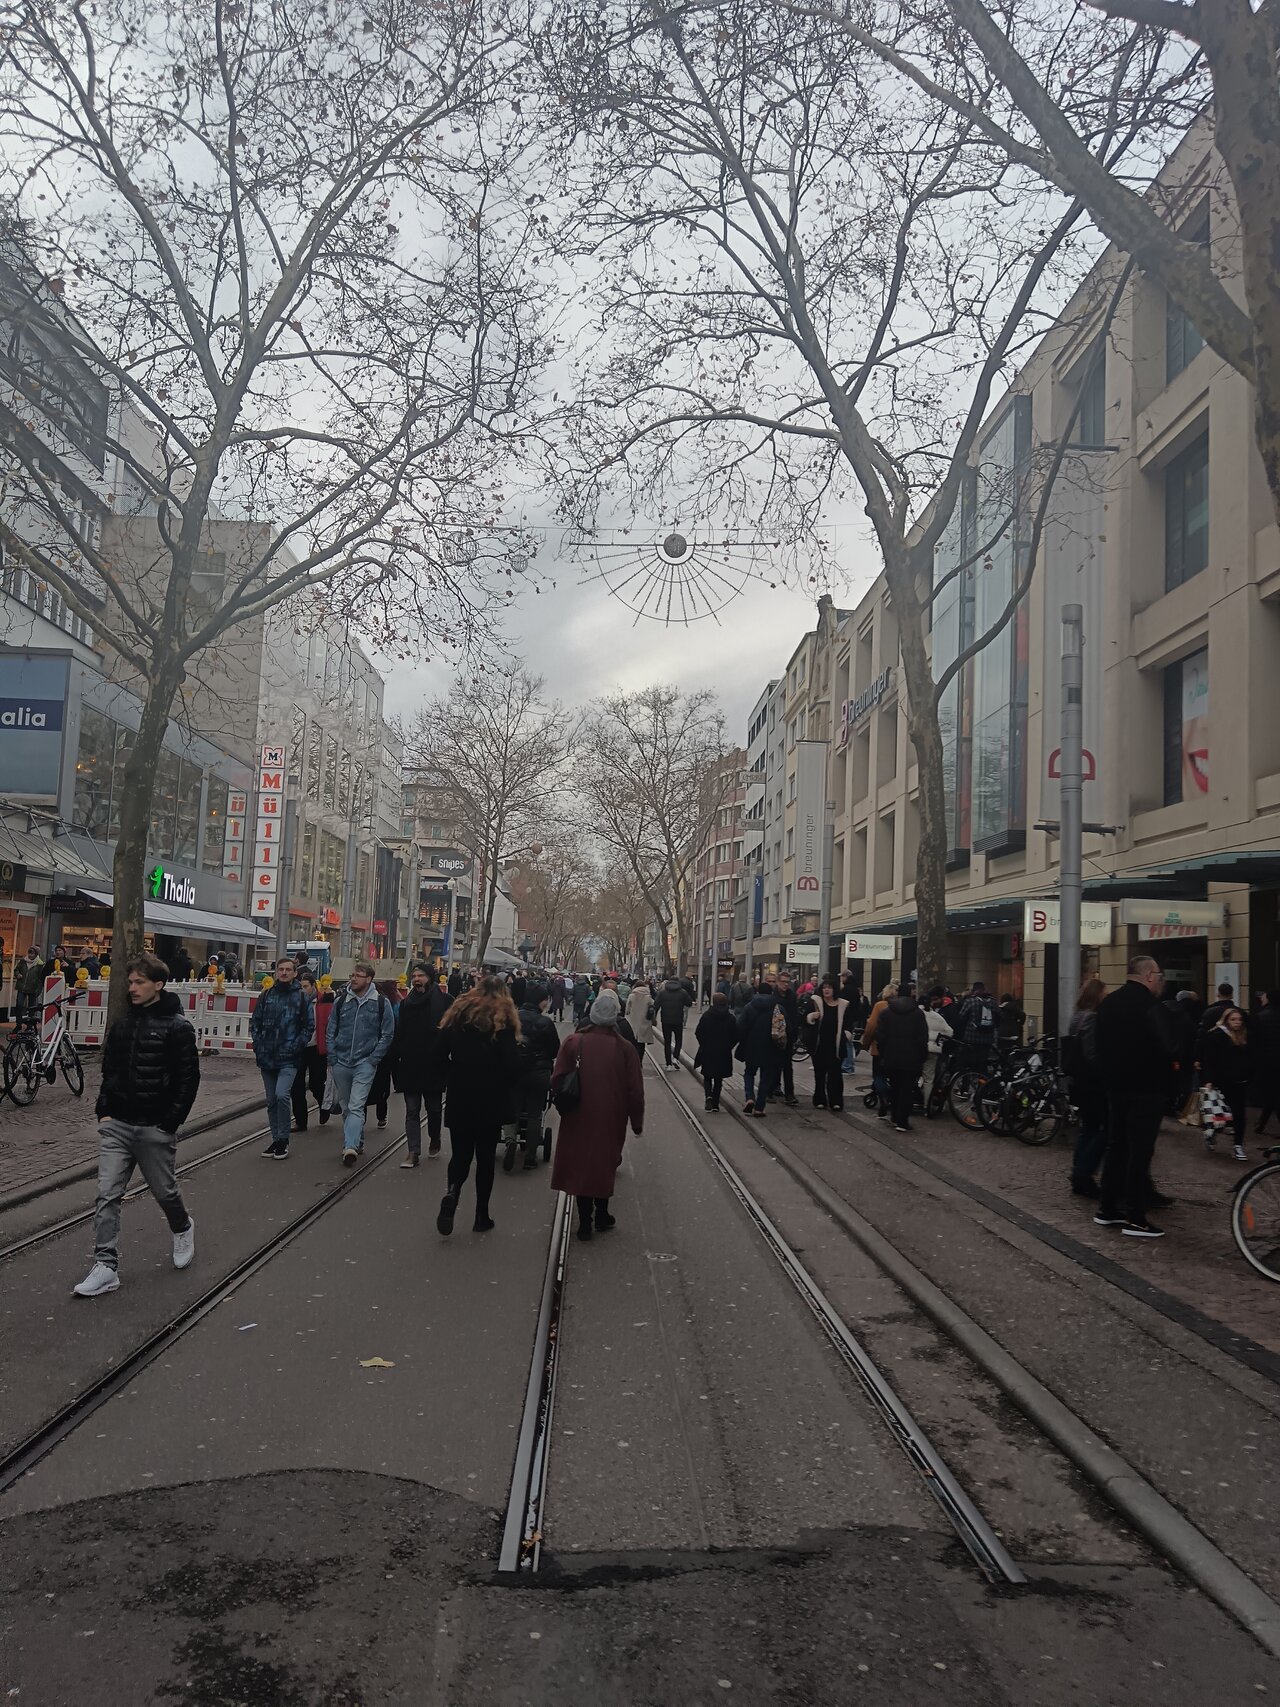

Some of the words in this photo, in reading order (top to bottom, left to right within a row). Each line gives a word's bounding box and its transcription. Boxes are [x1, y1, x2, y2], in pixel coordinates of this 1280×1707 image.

[1, 707, 46, 727] alia
[257, 773, 282, 911] Müller
[803, 814, 816, 873] breuninger
[163, 872, 196, 905] Thalia
